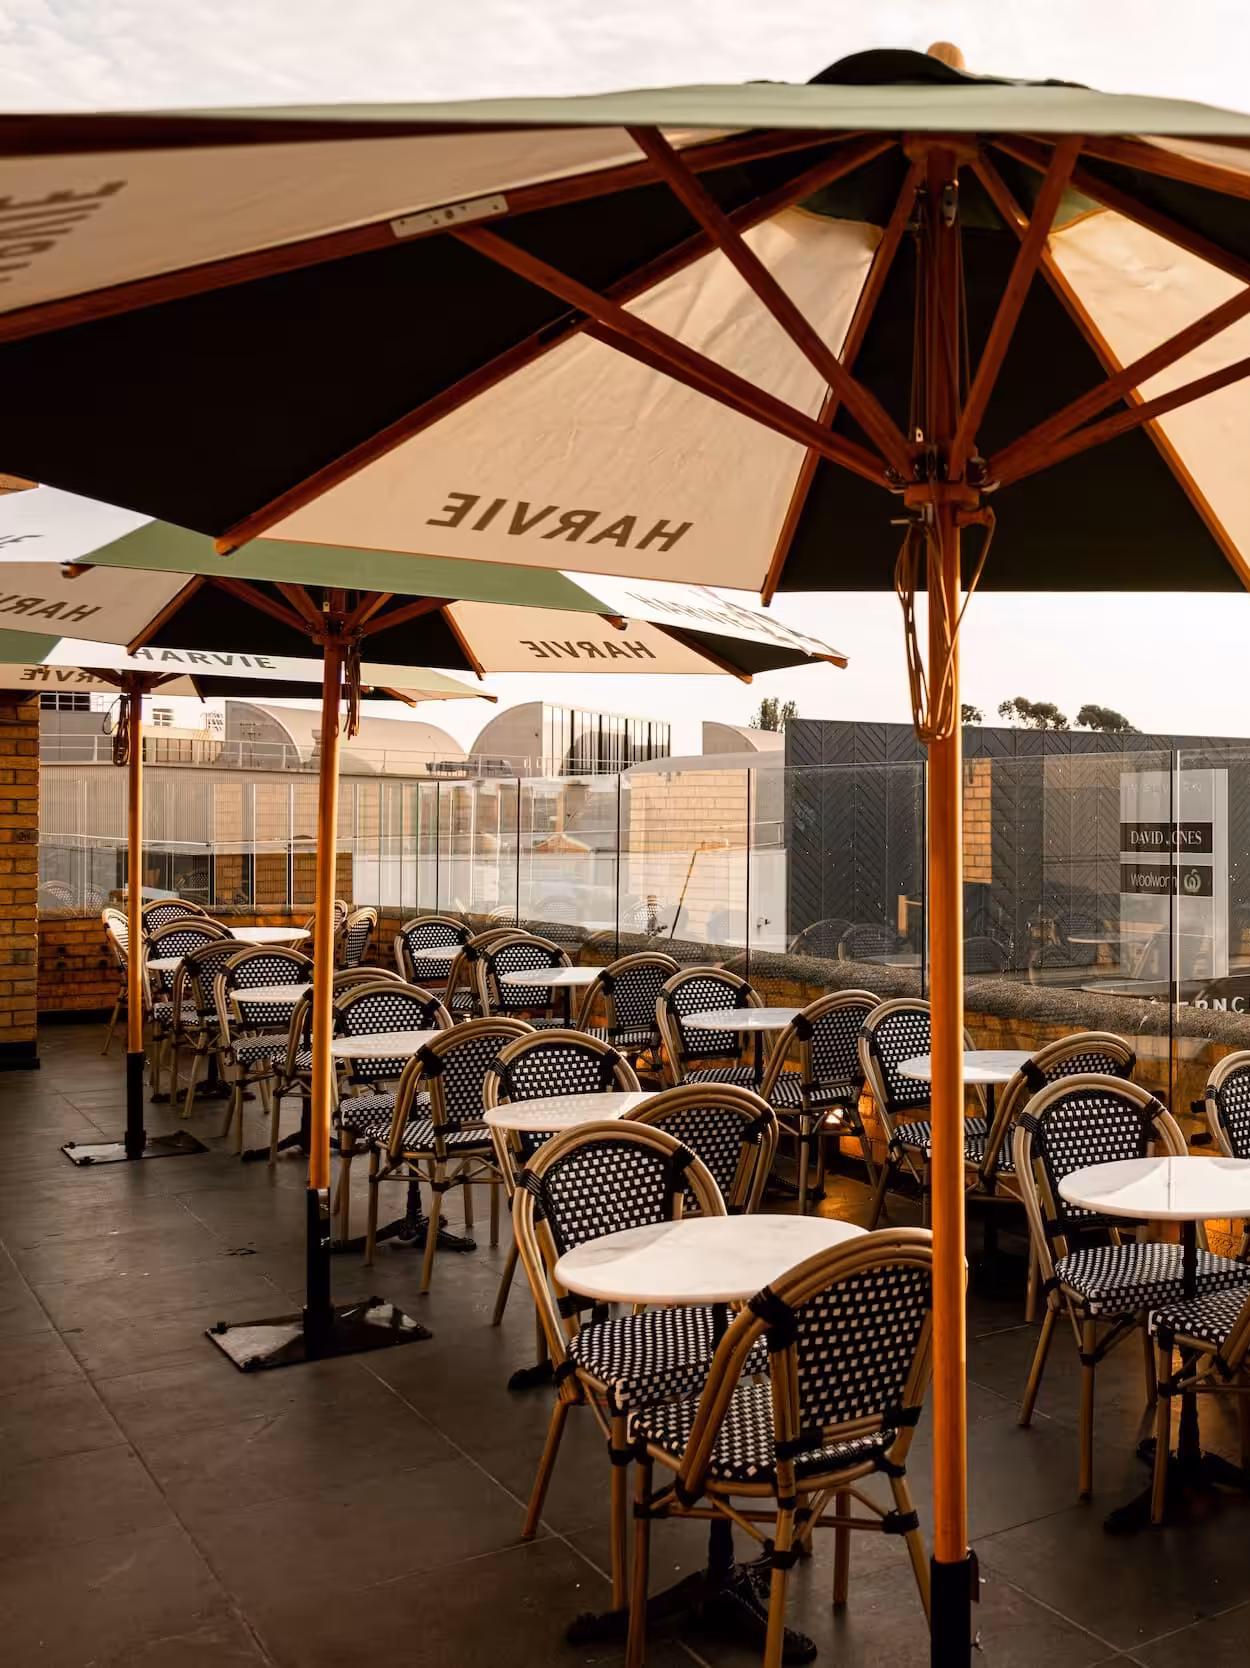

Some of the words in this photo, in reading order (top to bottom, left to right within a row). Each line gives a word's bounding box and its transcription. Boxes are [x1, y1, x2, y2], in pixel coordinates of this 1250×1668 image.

[129, 648, 277, 669] HARVIE
[1130, 830, 1164, 845] DAVID
[1165, 830, 1202, 845] ONES
[1130, 871, 1178, 888] Woolworh
